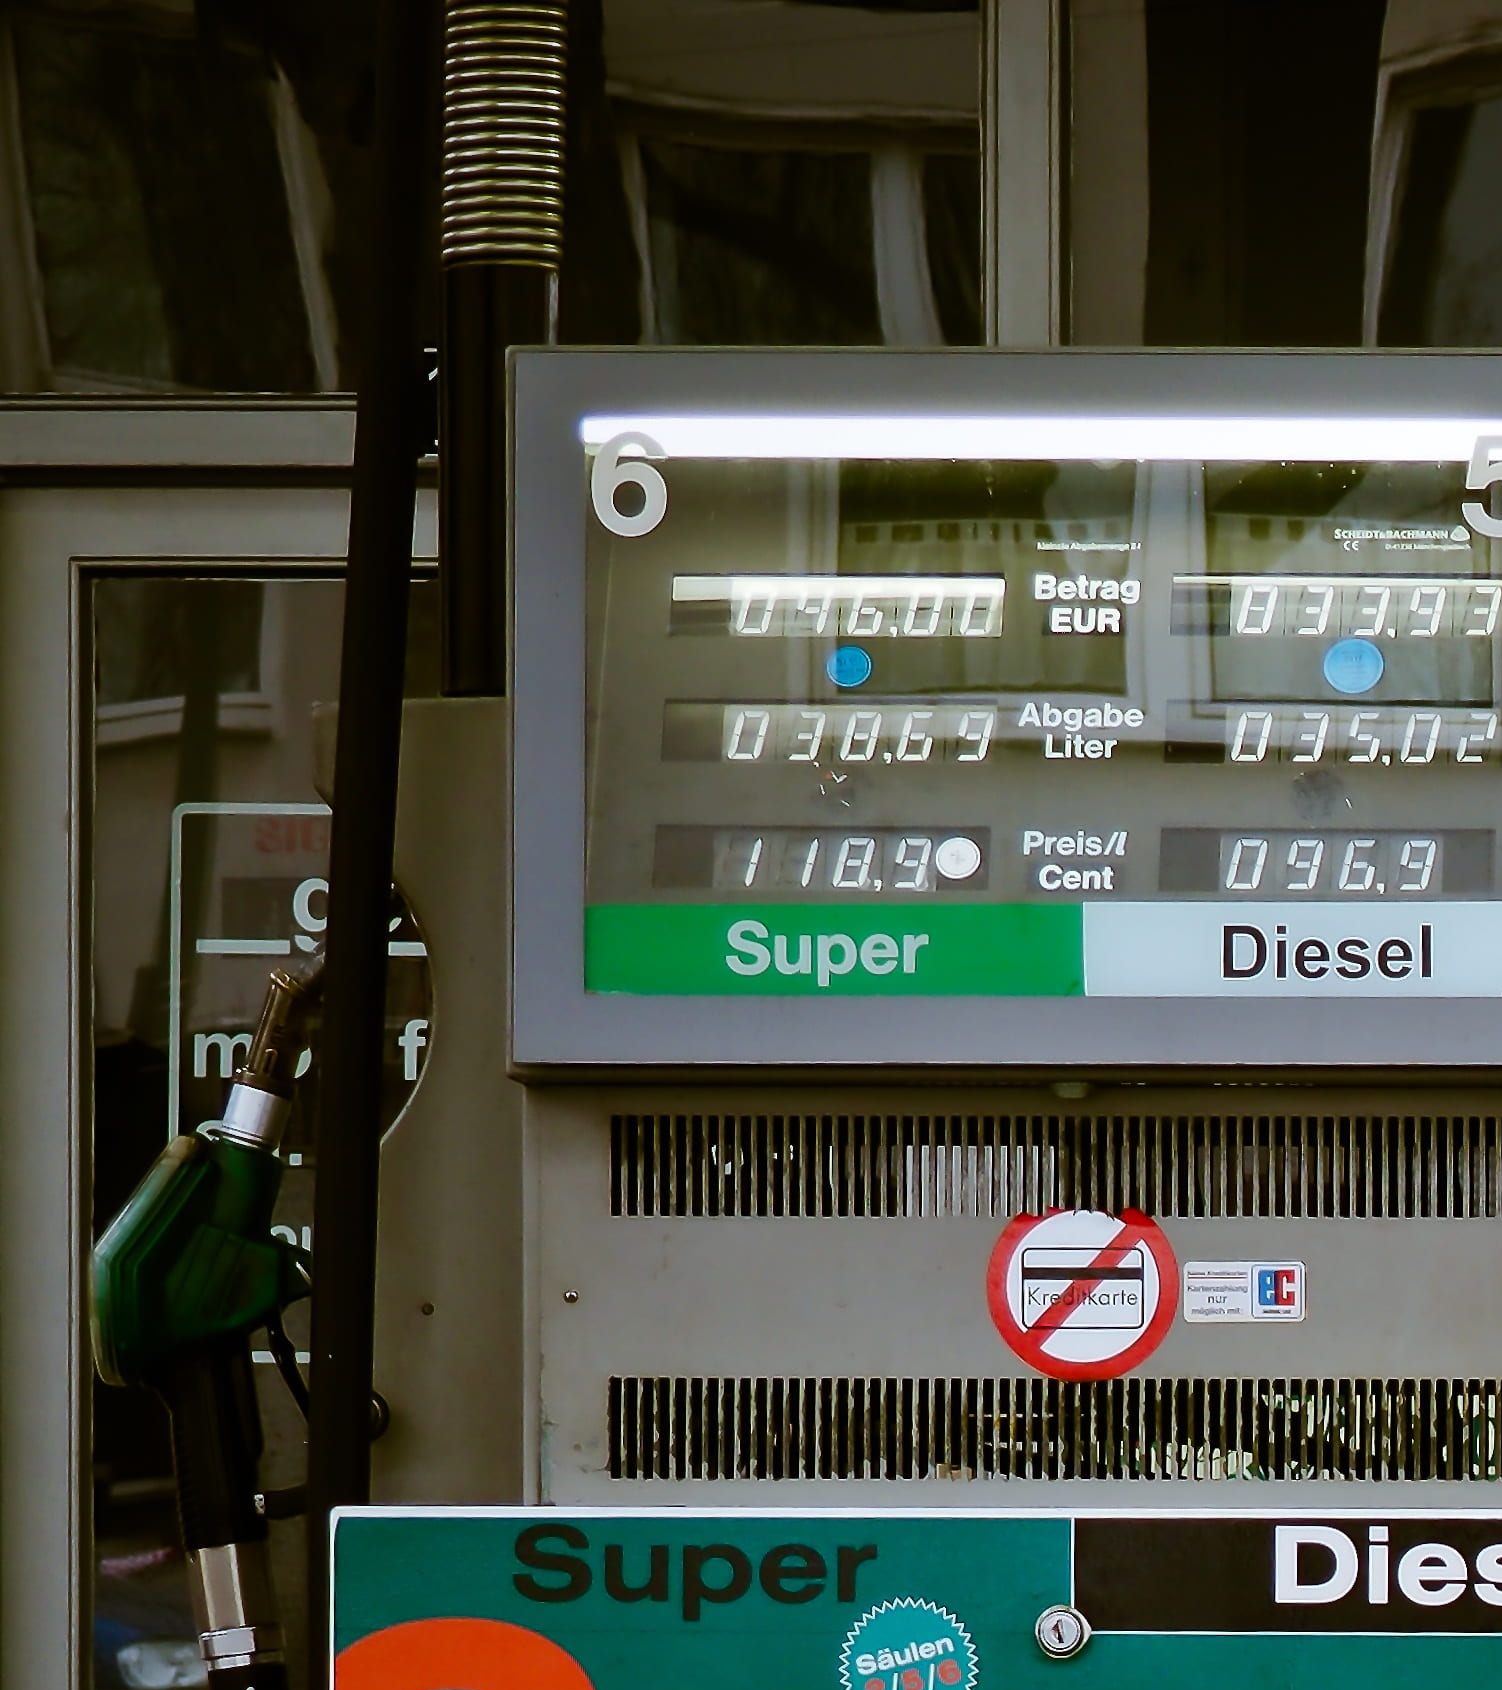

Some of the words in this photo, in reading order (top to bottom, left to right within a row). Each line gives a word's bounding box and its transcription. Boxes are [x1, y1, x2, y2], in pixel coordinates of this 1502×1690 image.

[591, 430, 669, 538] 6
[1034, 573, 1141, 605] Betrag
[1049, 607, 1122, 634] EUR
[727, 711, 995, 765] 038,69
[1018, 702, 1144, 731] Abgabe
[1230, 712, 1498, 767] 035,02
[1043, 733, 1118, 762] Liter
[744, 837, 933, 892] 118,9
[1040, 865, 1116, 892] Cent
[1225, 839, 1437, 895] 096,9
[725, 921, 931, 987] Super
[1224, 926, 1432, 979] Diesel
[1027, 1286, 1139, 1307] Kreditkarte
[1207, 1293, 1228, 1305] nur
[511, 1523, 877, 1621] Super
[855, 1637, 955, 1676] Säulen
